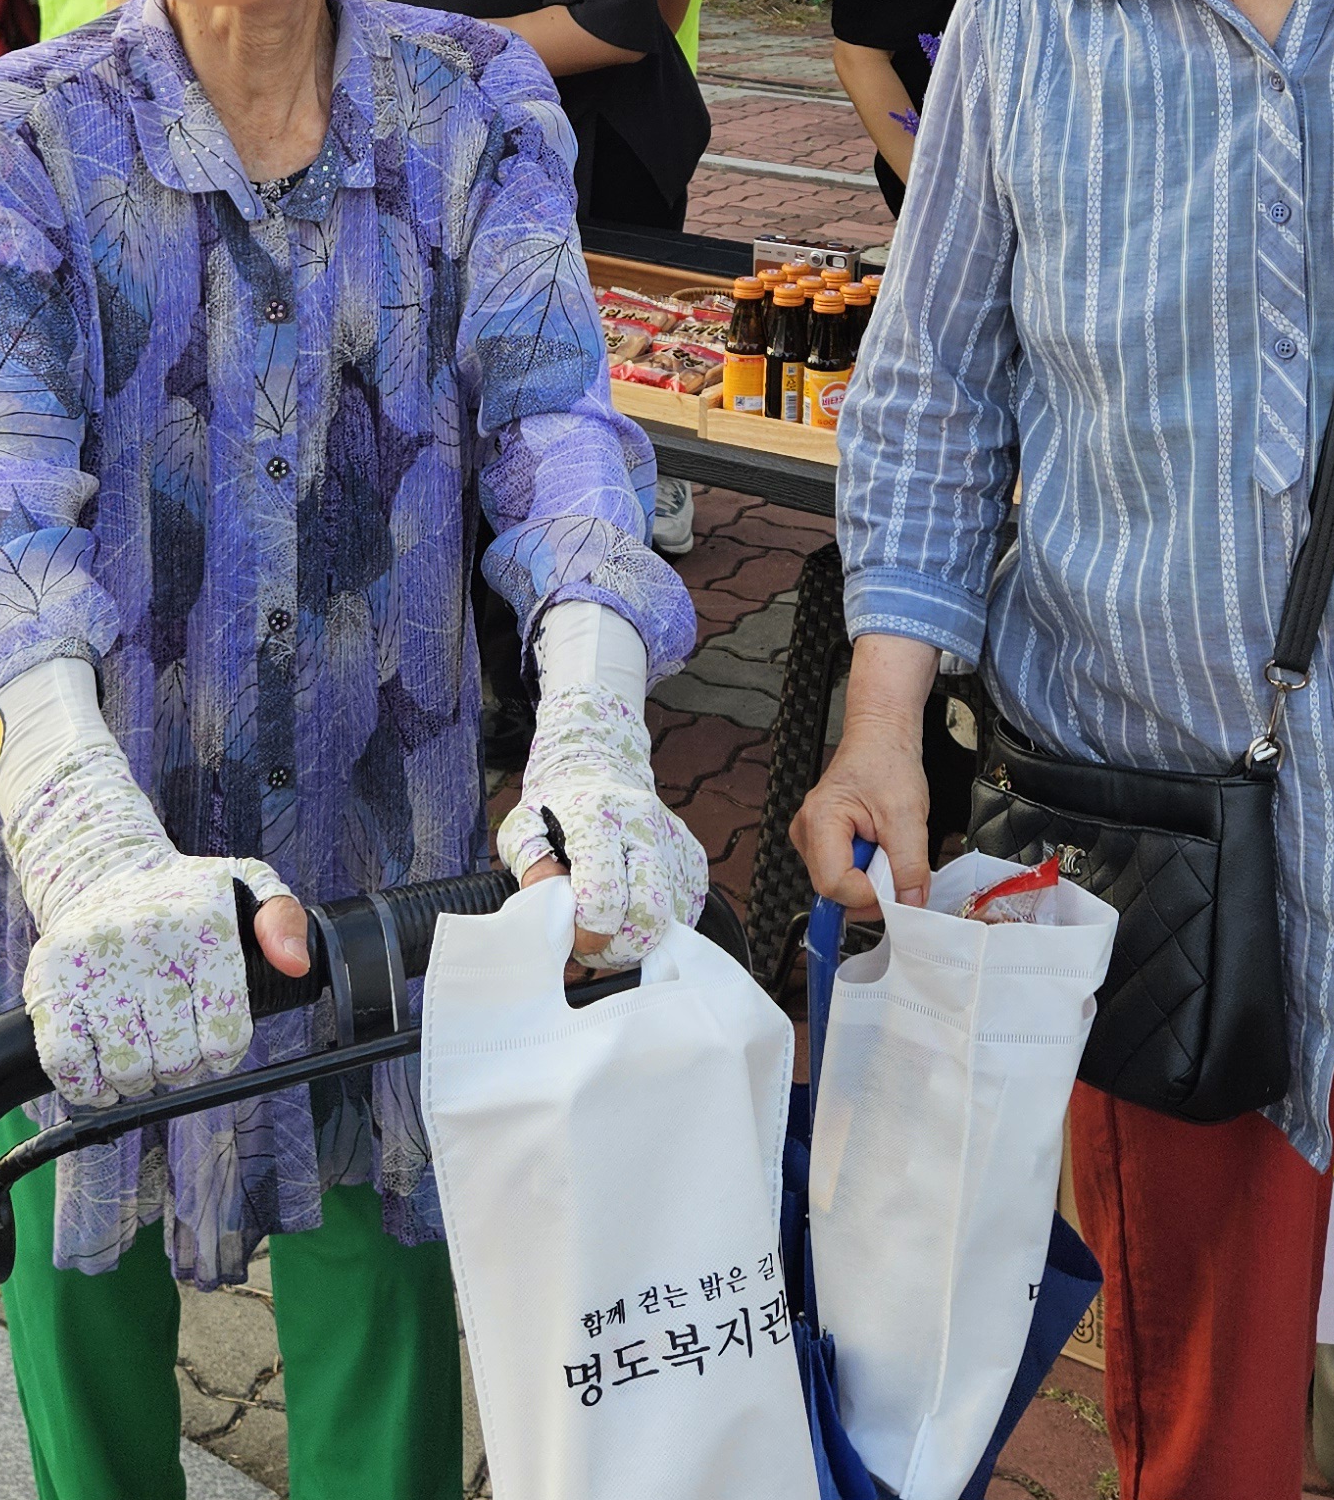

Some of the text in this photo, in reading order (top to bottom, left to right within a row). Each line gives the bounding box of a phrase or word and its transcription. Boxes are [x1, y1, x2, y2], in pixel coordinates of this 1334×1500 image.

[580, 1252, 776, 1338] 함께 걷는 밝은 길
[563, 1290, 791, 1406] 명도복지관
